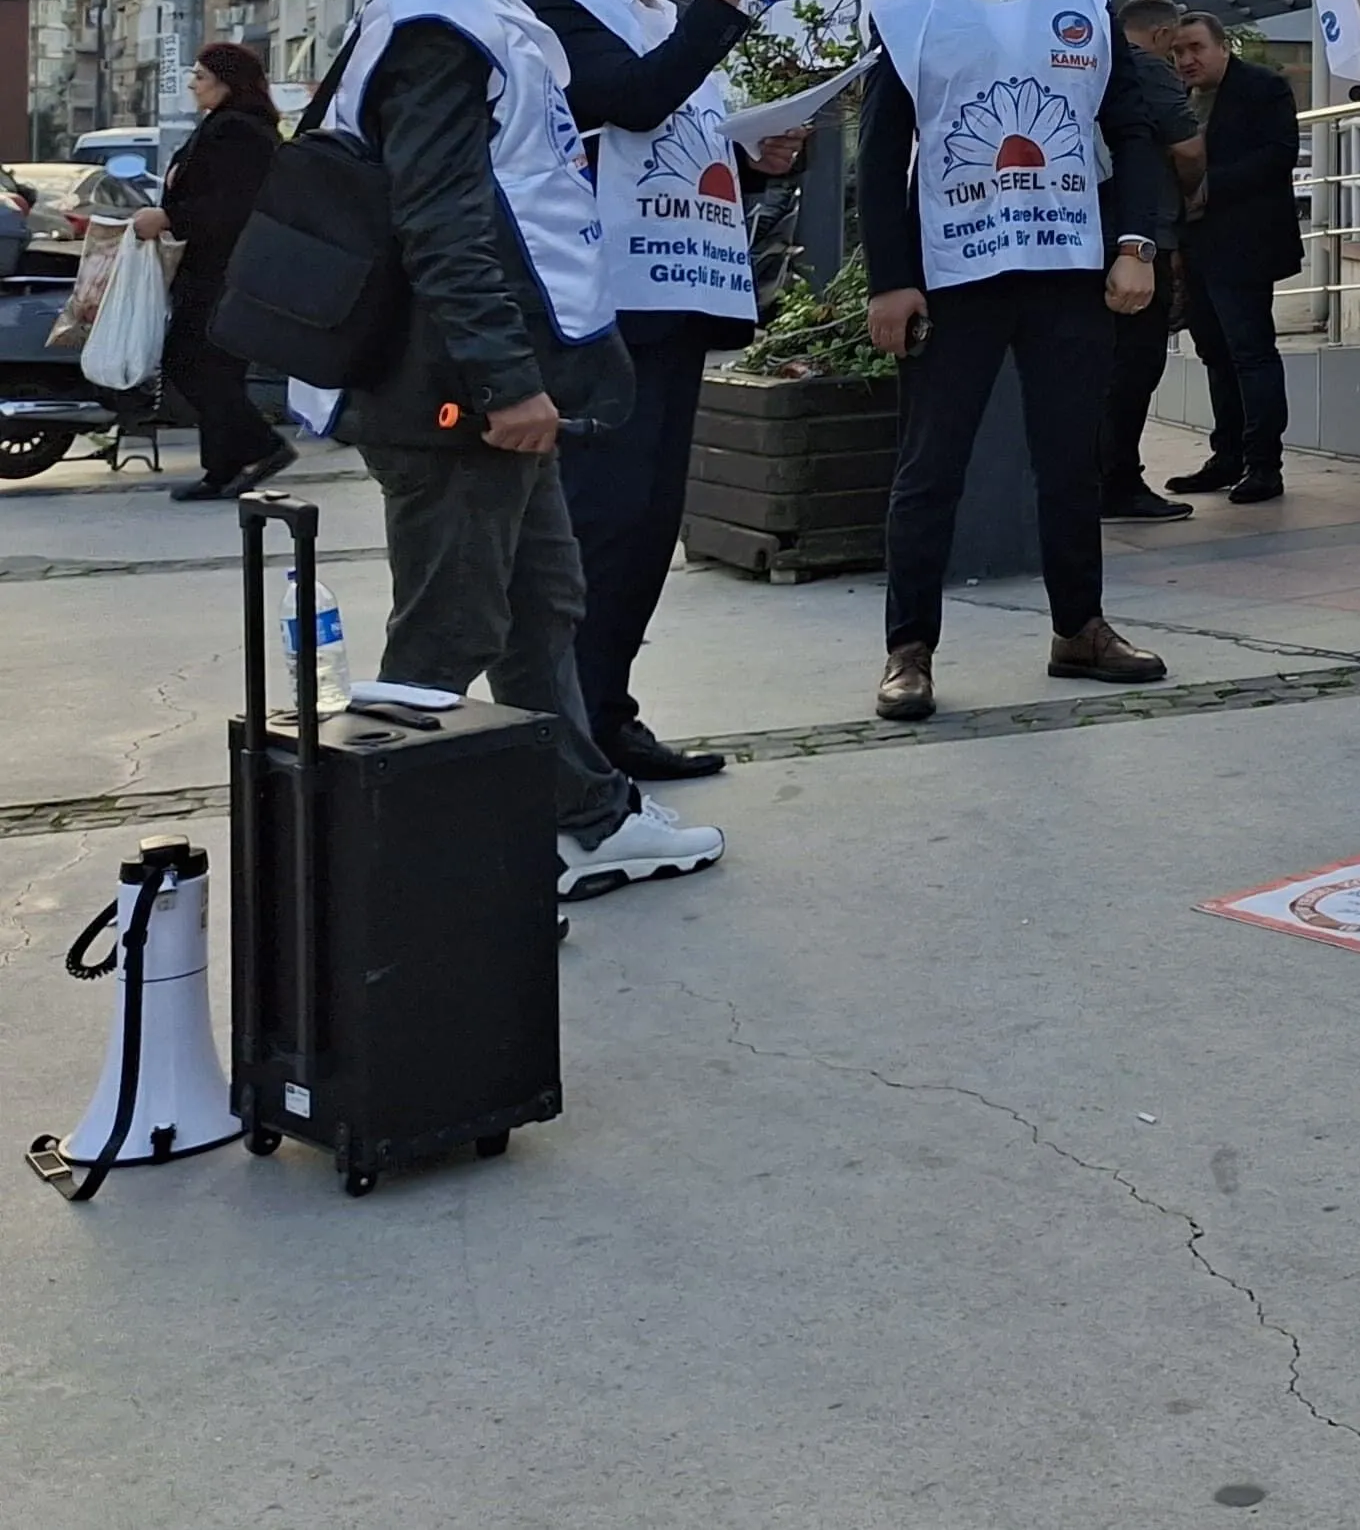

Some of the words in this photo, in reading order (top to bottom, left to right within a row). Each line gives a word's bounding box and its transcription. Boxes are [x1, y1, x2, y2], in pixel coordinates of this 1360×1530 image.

[944, 180, 987, 207] TÜM
[1061, 173, 1086, 193] SEN
[636, 193, 691, 219] TÜM
[694, 199, 737, 229] YEREL
[943, 214, 996, 240] Emek
[629, 236, 698, 256] Emek
[650, 263, 708, 288] Güçlü
[709, 268, 726, 289] Bir
